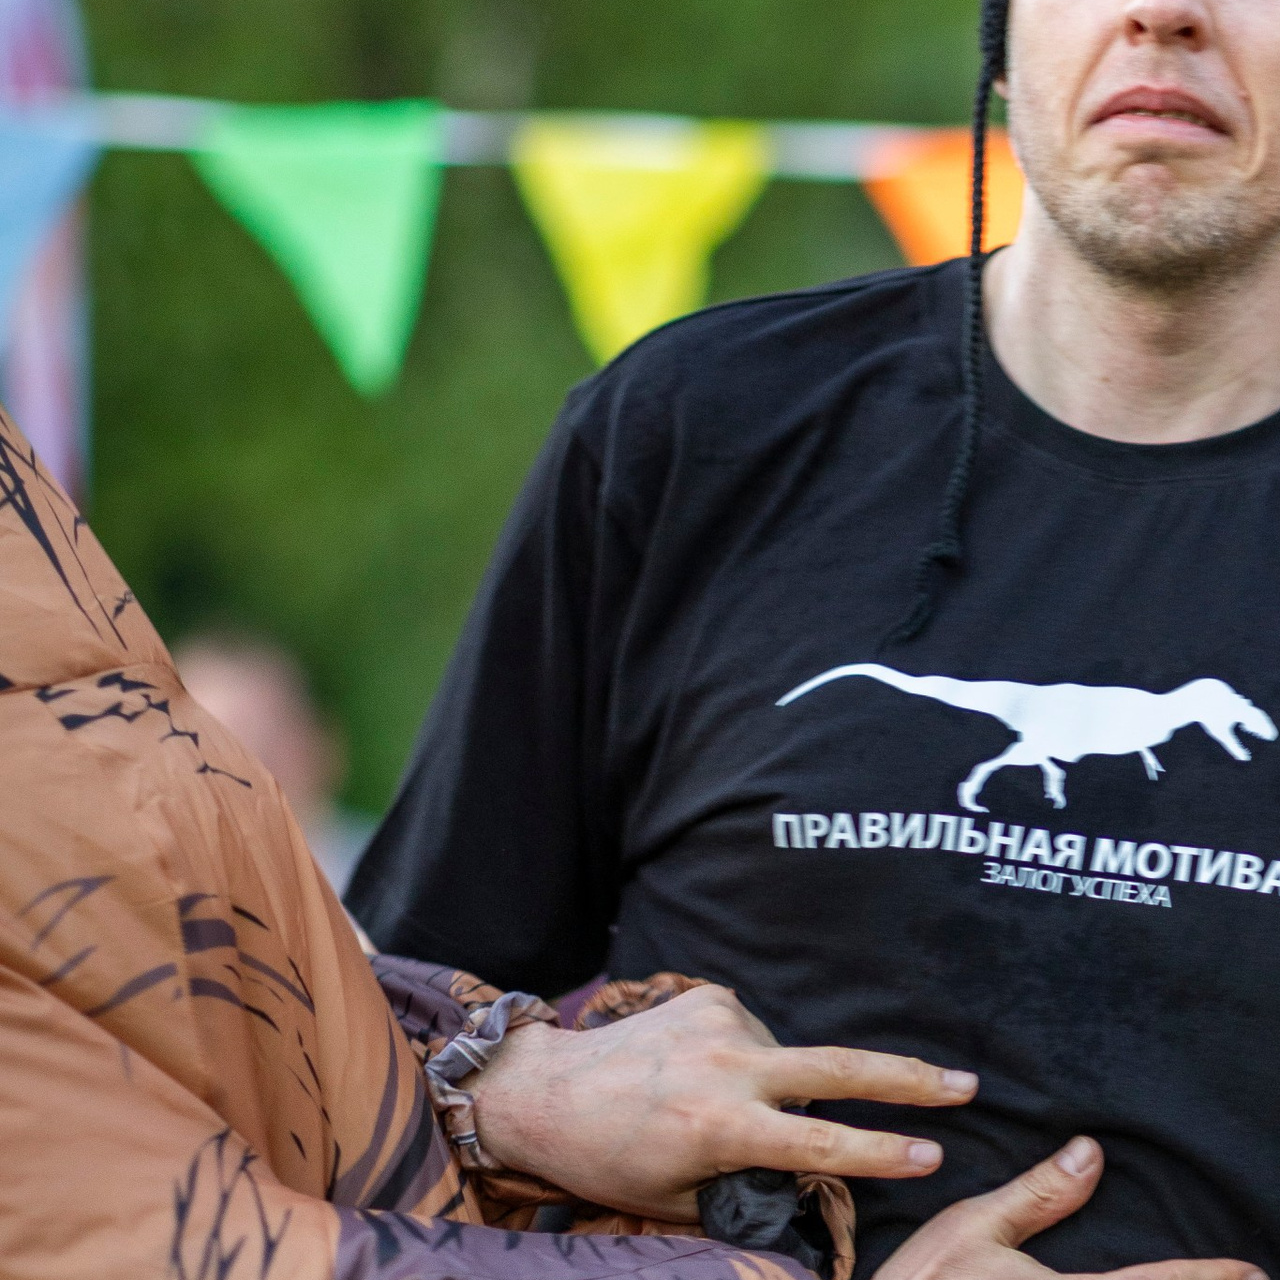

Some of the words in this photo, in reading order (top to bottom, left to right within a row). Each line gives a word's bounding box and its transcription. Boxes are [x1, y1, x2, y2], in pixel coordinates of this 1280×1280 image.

[772, 812, 1087, 871] ПРАВИЛЬНАЯ
[980, 861, 1070, 894] ЗАЛОГ
[1068, 874, 1173, 908] УСПЕХА
